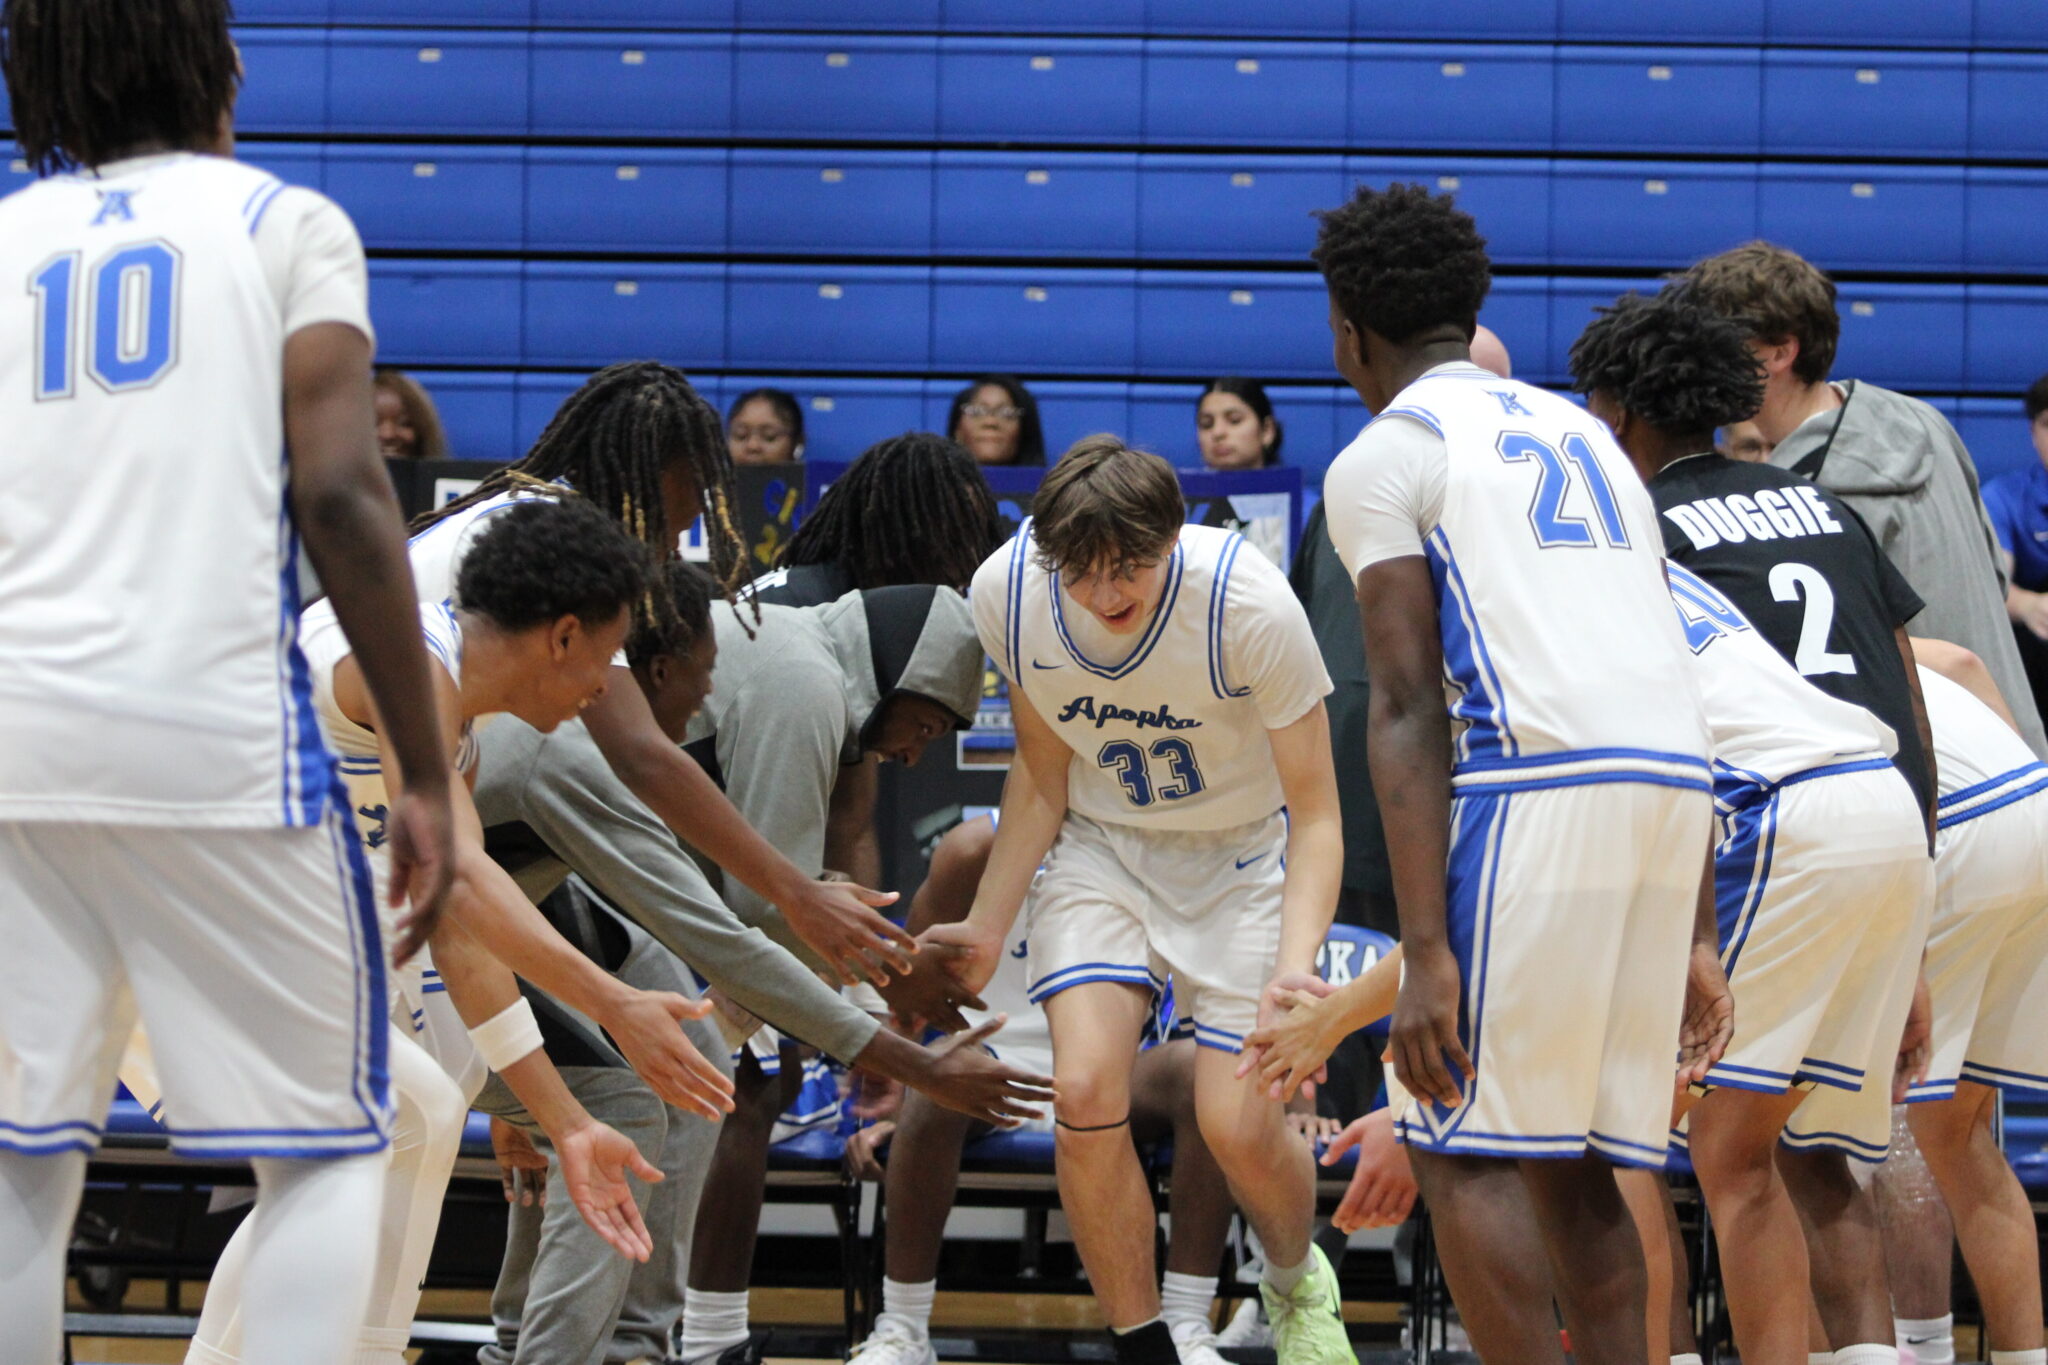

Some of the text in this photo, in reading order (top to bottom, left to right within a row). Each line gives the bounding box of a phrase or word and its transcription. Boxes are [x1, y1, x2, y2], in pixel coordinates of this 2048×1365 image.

[26, 237, 184, 403] 10
[1495, 430, 1632, 550] 21
[1662, 485, 1844, 551] DUGGIE
[1768, 562, 1857, 676] 2
[1057, 696, 1203, 730] Apopka
[1097, 735, 1207, 807] 33
